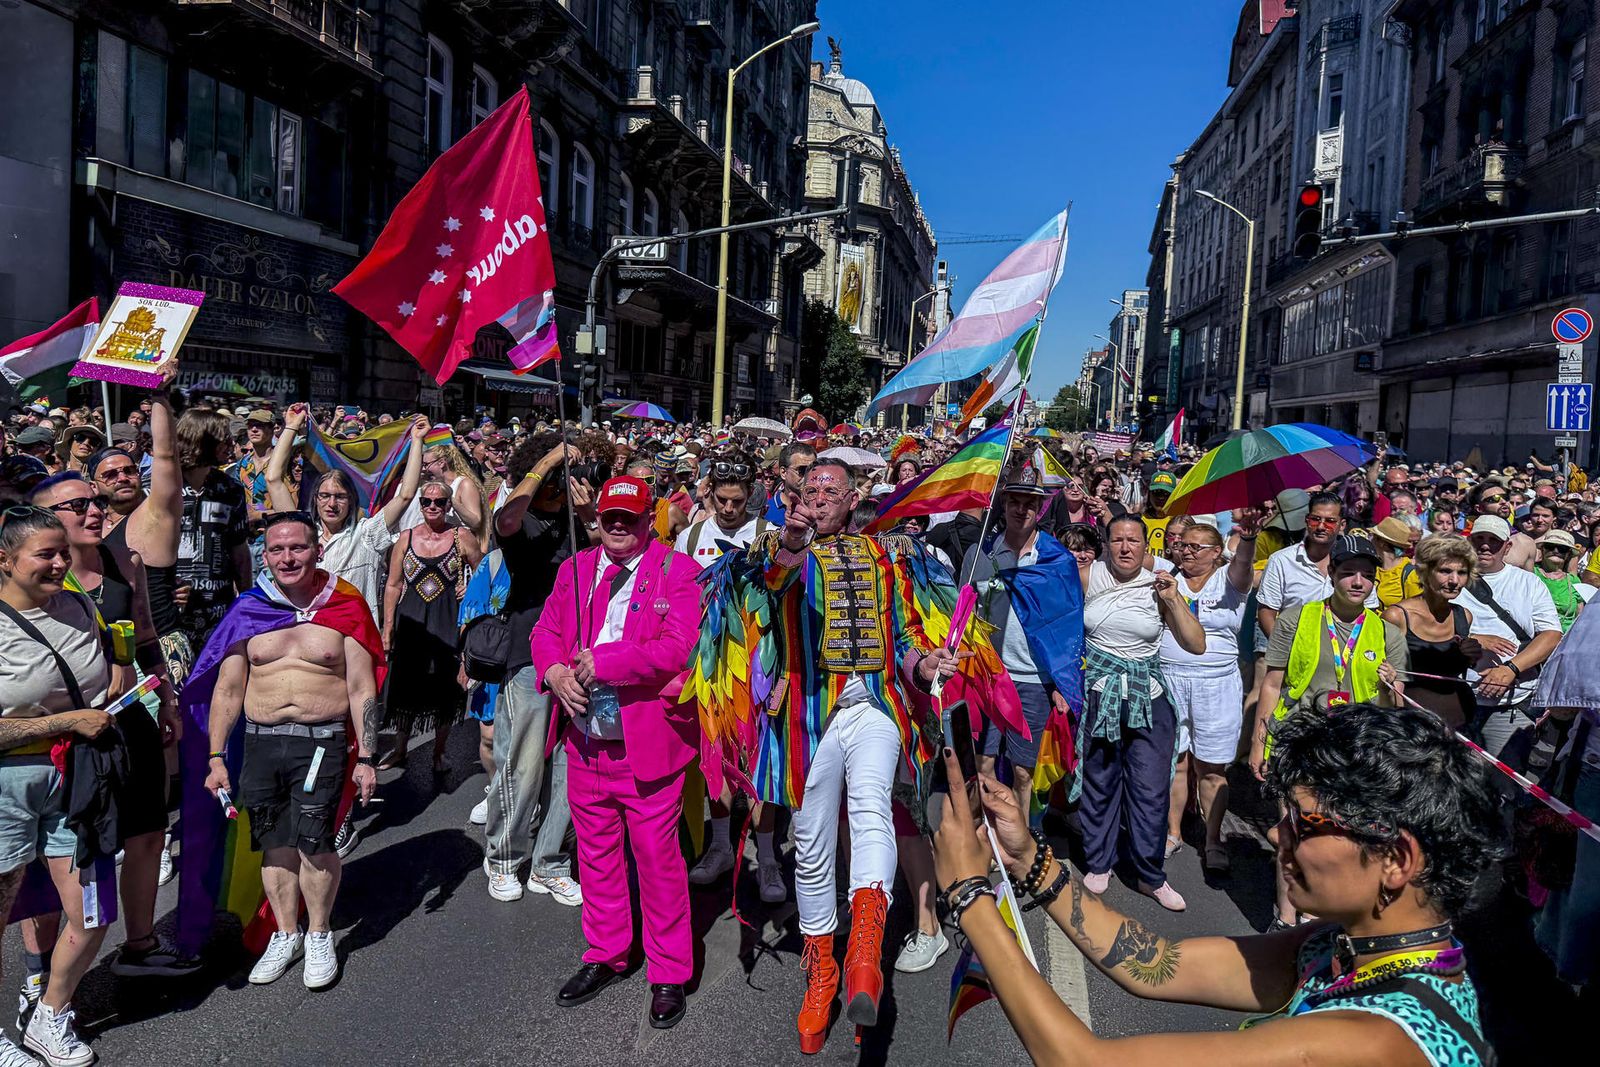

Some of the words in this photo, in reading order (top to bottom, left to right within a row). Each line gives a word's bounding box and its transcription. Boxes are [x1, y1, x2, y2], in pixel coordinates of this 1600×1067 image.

[249, 284, 319, 315] SZALON
[753, 301, 776, 314] OZI
[241, 375, 297, 394] 267-0355
[1371, 961, 1397, 975] PRIDE
